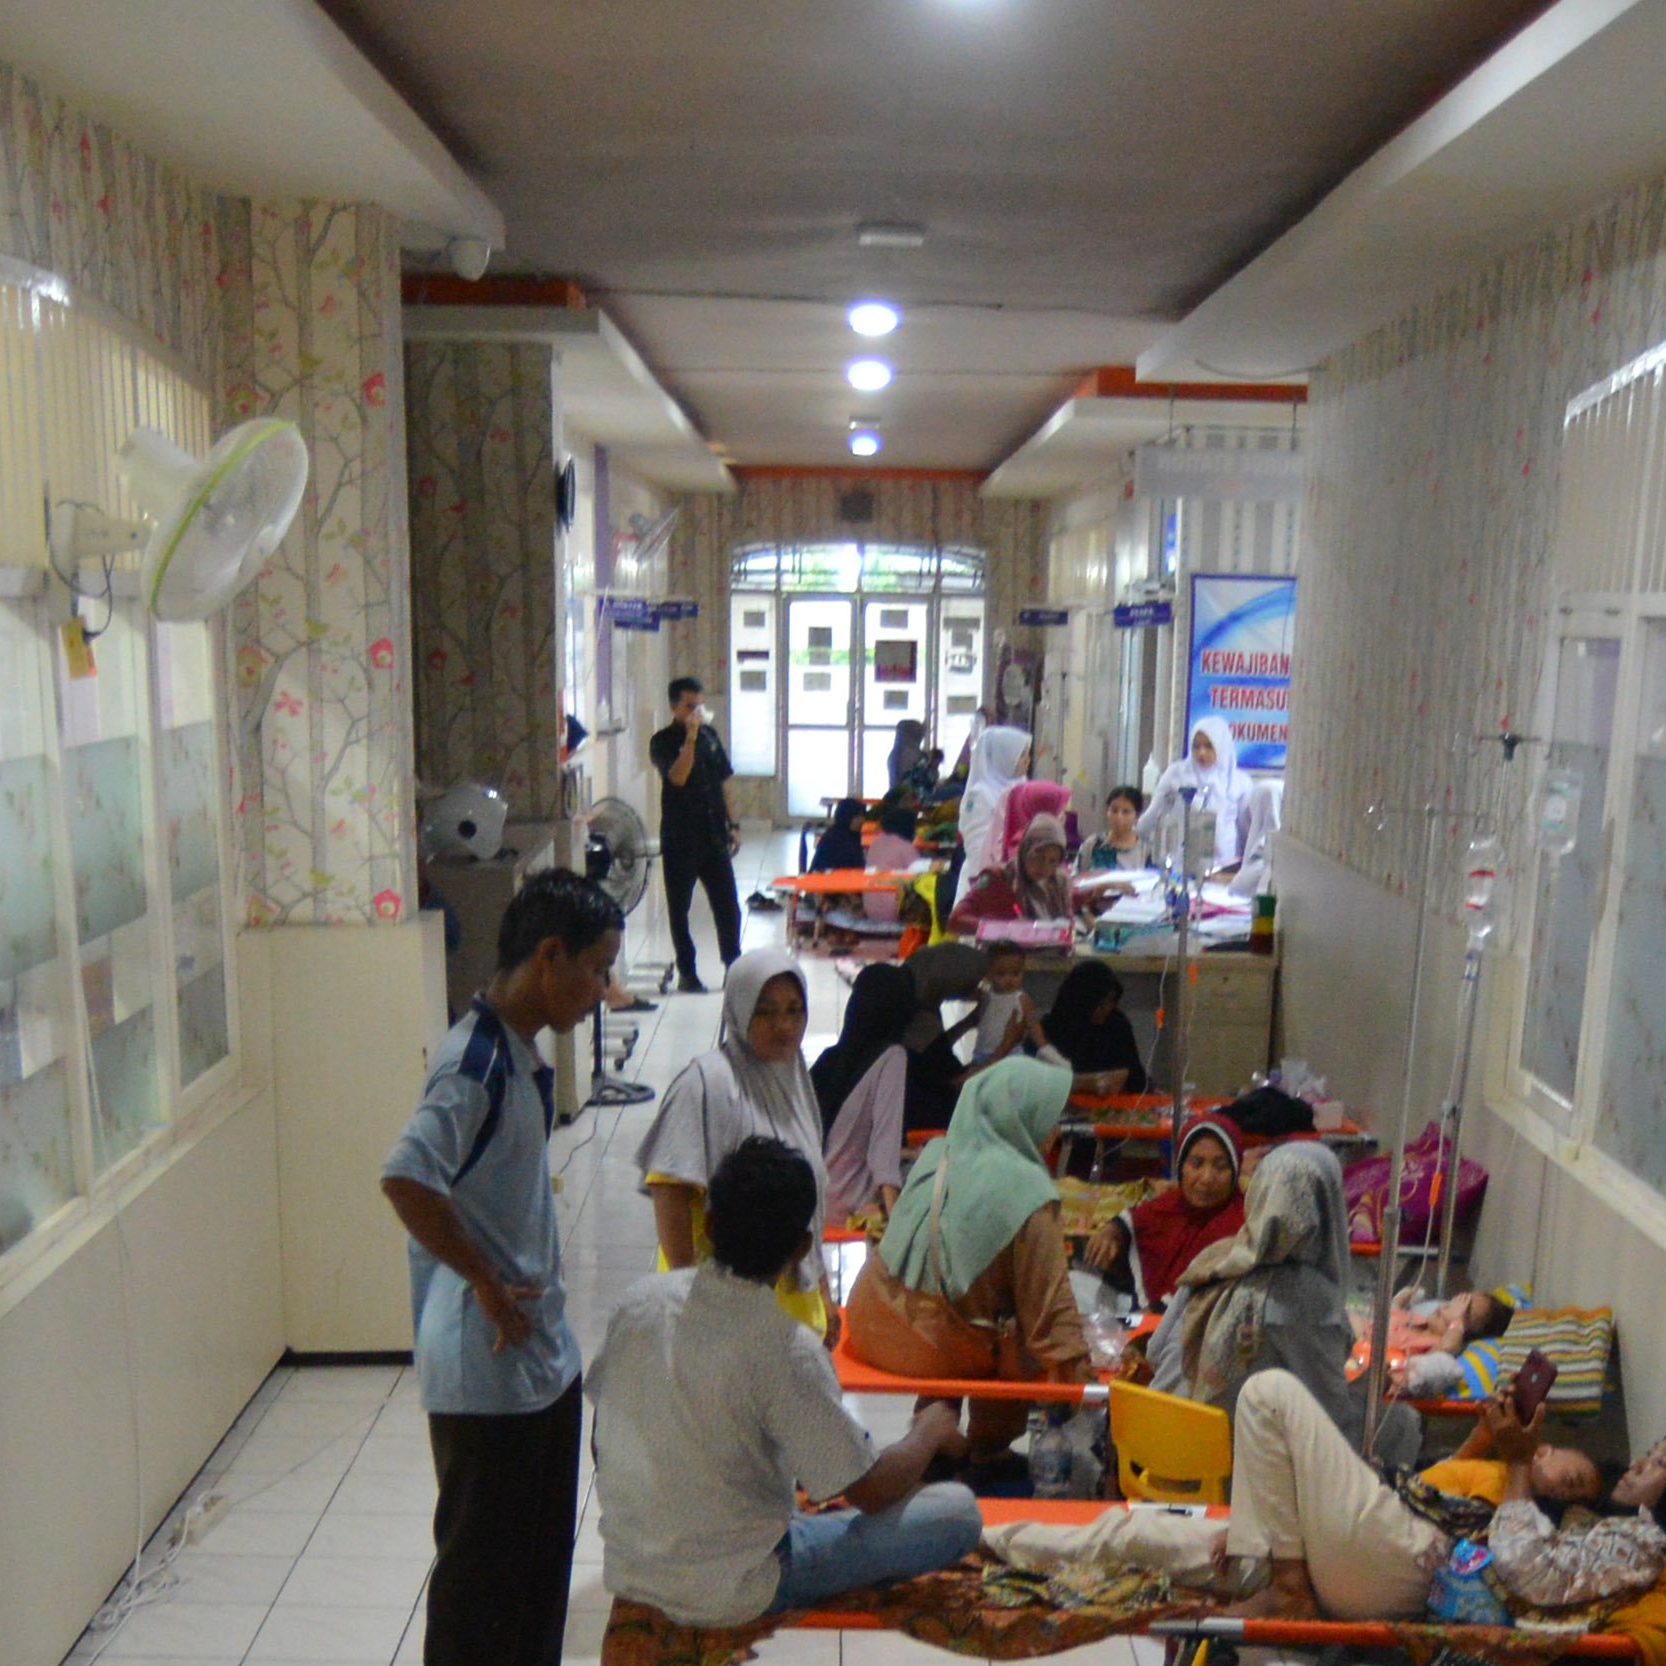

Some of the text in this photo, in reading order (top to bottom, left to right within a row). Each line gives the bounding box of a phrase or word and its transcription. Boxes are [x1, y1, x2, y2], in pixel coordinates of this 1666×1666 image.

[1201, 650, 1290, 676] KEWAJIBAN
[1210, 685, 1288, 710] TERMASU
[1229, 722, 1289, 743] OKUMEN
